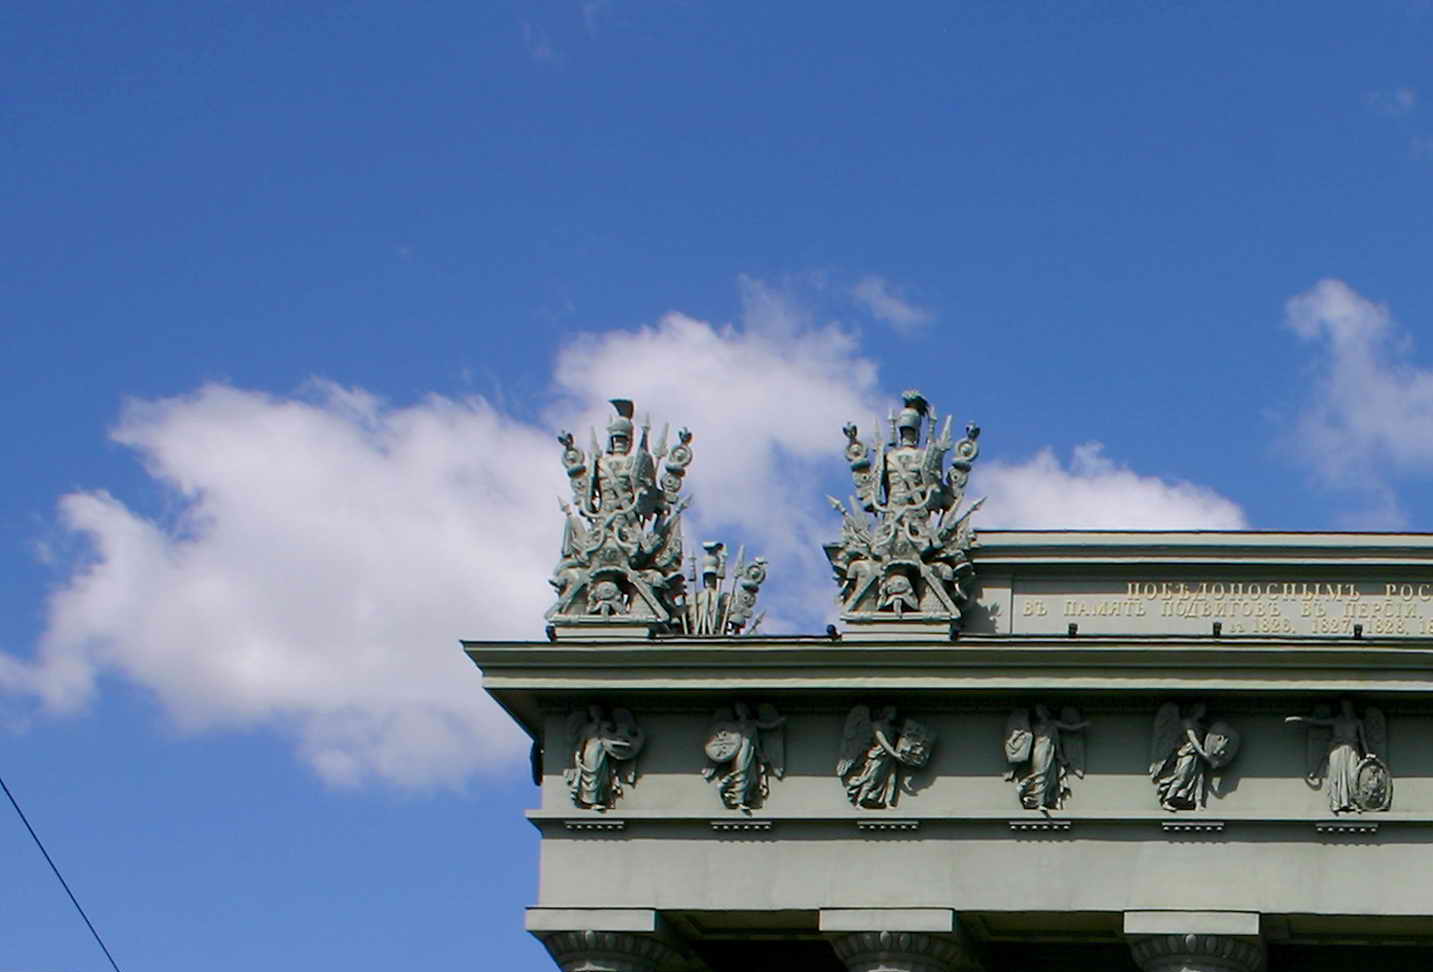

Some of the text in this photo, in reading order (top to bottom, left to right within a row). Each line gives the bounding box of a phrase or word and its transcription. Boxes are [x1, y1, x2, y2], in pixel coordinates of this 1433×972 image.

[1023, 600, 1048, 616] ВЪ
[1063, 600, 1146, 617] ПАМЯТЬ
[1161, 601, 1281, 618] ПОДВИГОВЪ
[1300, 602, 1327, 617] ВЪ
